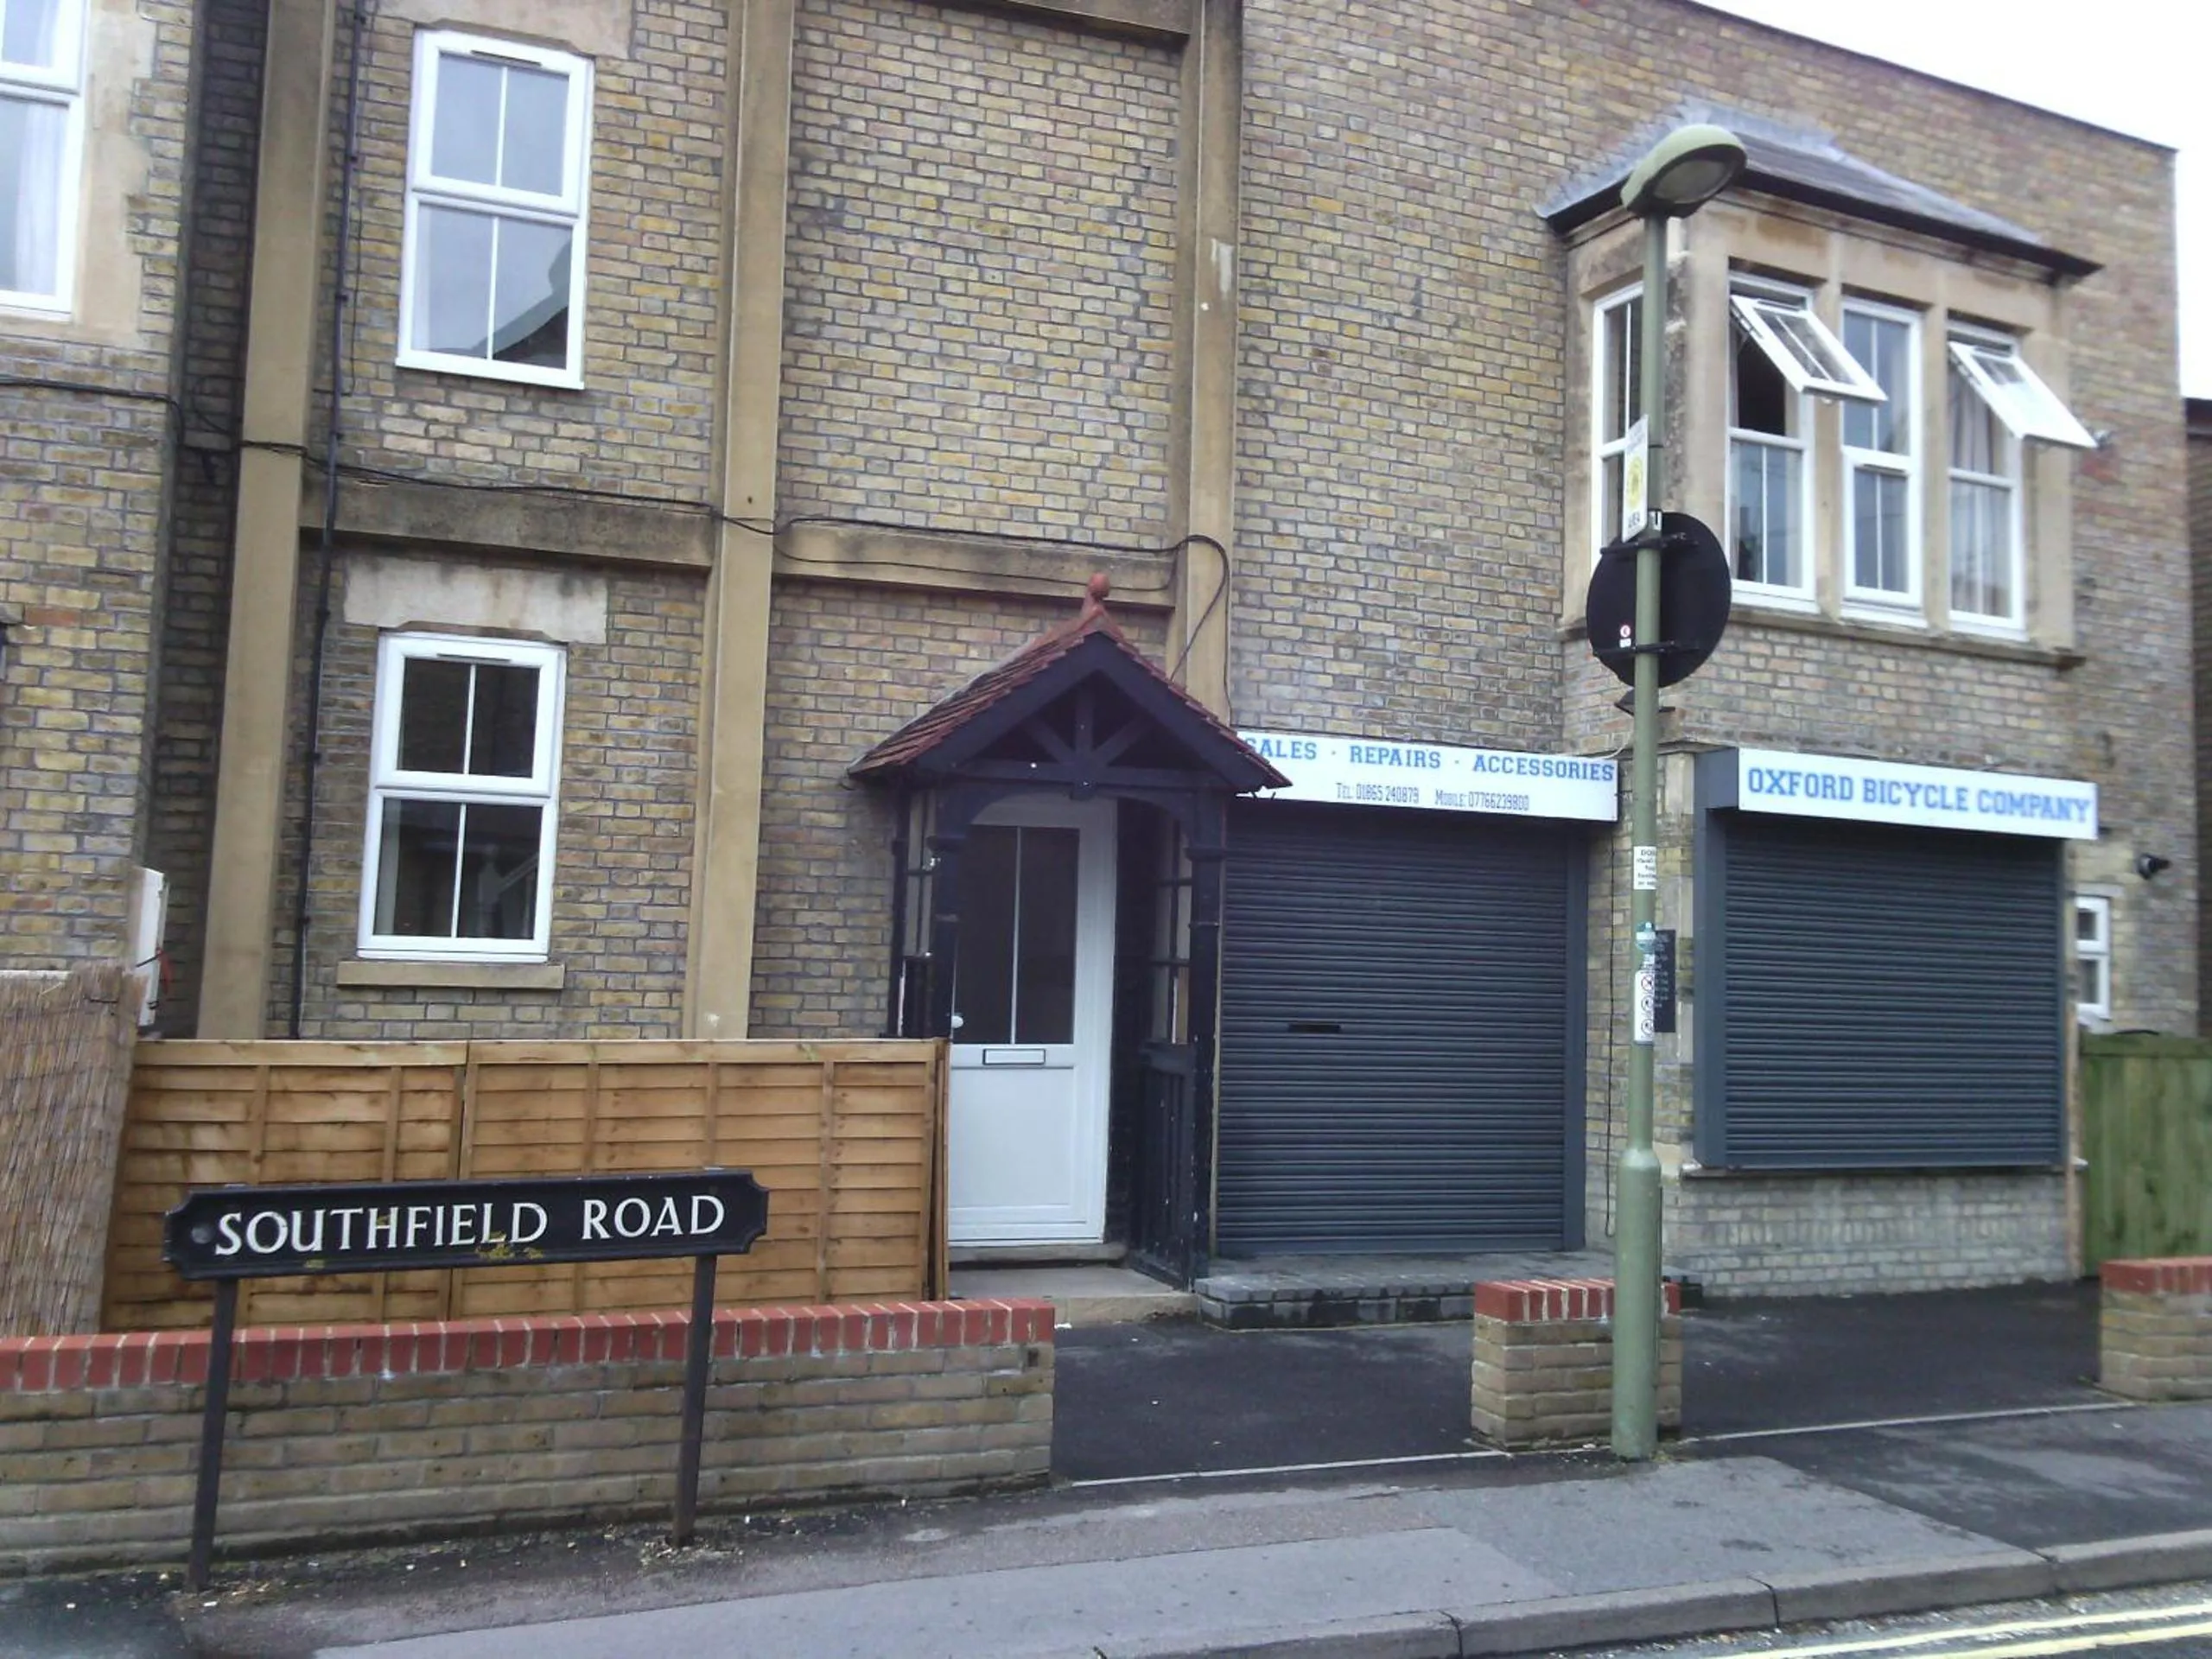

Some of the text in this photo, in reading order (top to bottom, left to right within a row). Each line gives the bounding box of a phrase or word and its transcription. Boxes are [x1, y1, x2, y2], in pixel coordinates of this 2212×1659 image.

[1350, 746, 1441, 769] REPAIRS
[1473, 755, 1614, 781] ACCESSORIES
[1748, 767, 2090, 823] OXFORD BICYCLE COMPANY
[214, 1194, 725, 1255] SOUTHFIELD ROAD
